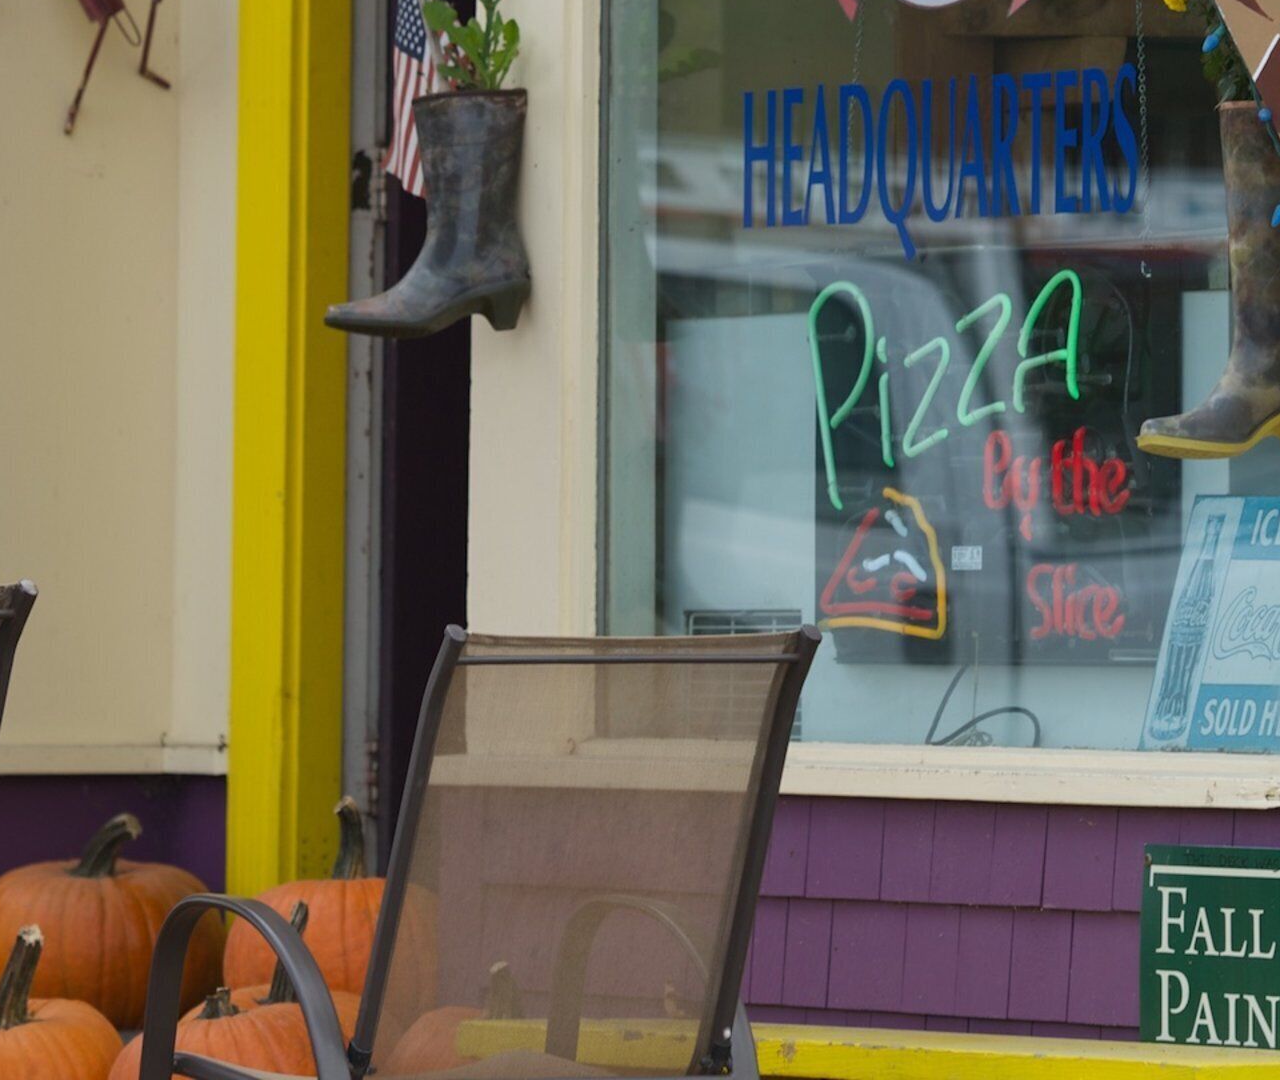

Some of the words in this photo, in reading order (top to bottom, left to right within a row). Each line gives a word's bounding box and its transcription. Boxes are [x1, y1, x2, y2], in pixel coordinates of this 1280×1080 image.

[743, 63, 1139, 260] HEADQUARTERS
[1050, 426, 1131, 517] the
[1026, 562, 1126, 641] Slice
[1200, 698, 1257, 737] SOLD
[1155, 886, 1277, 959] FALL
